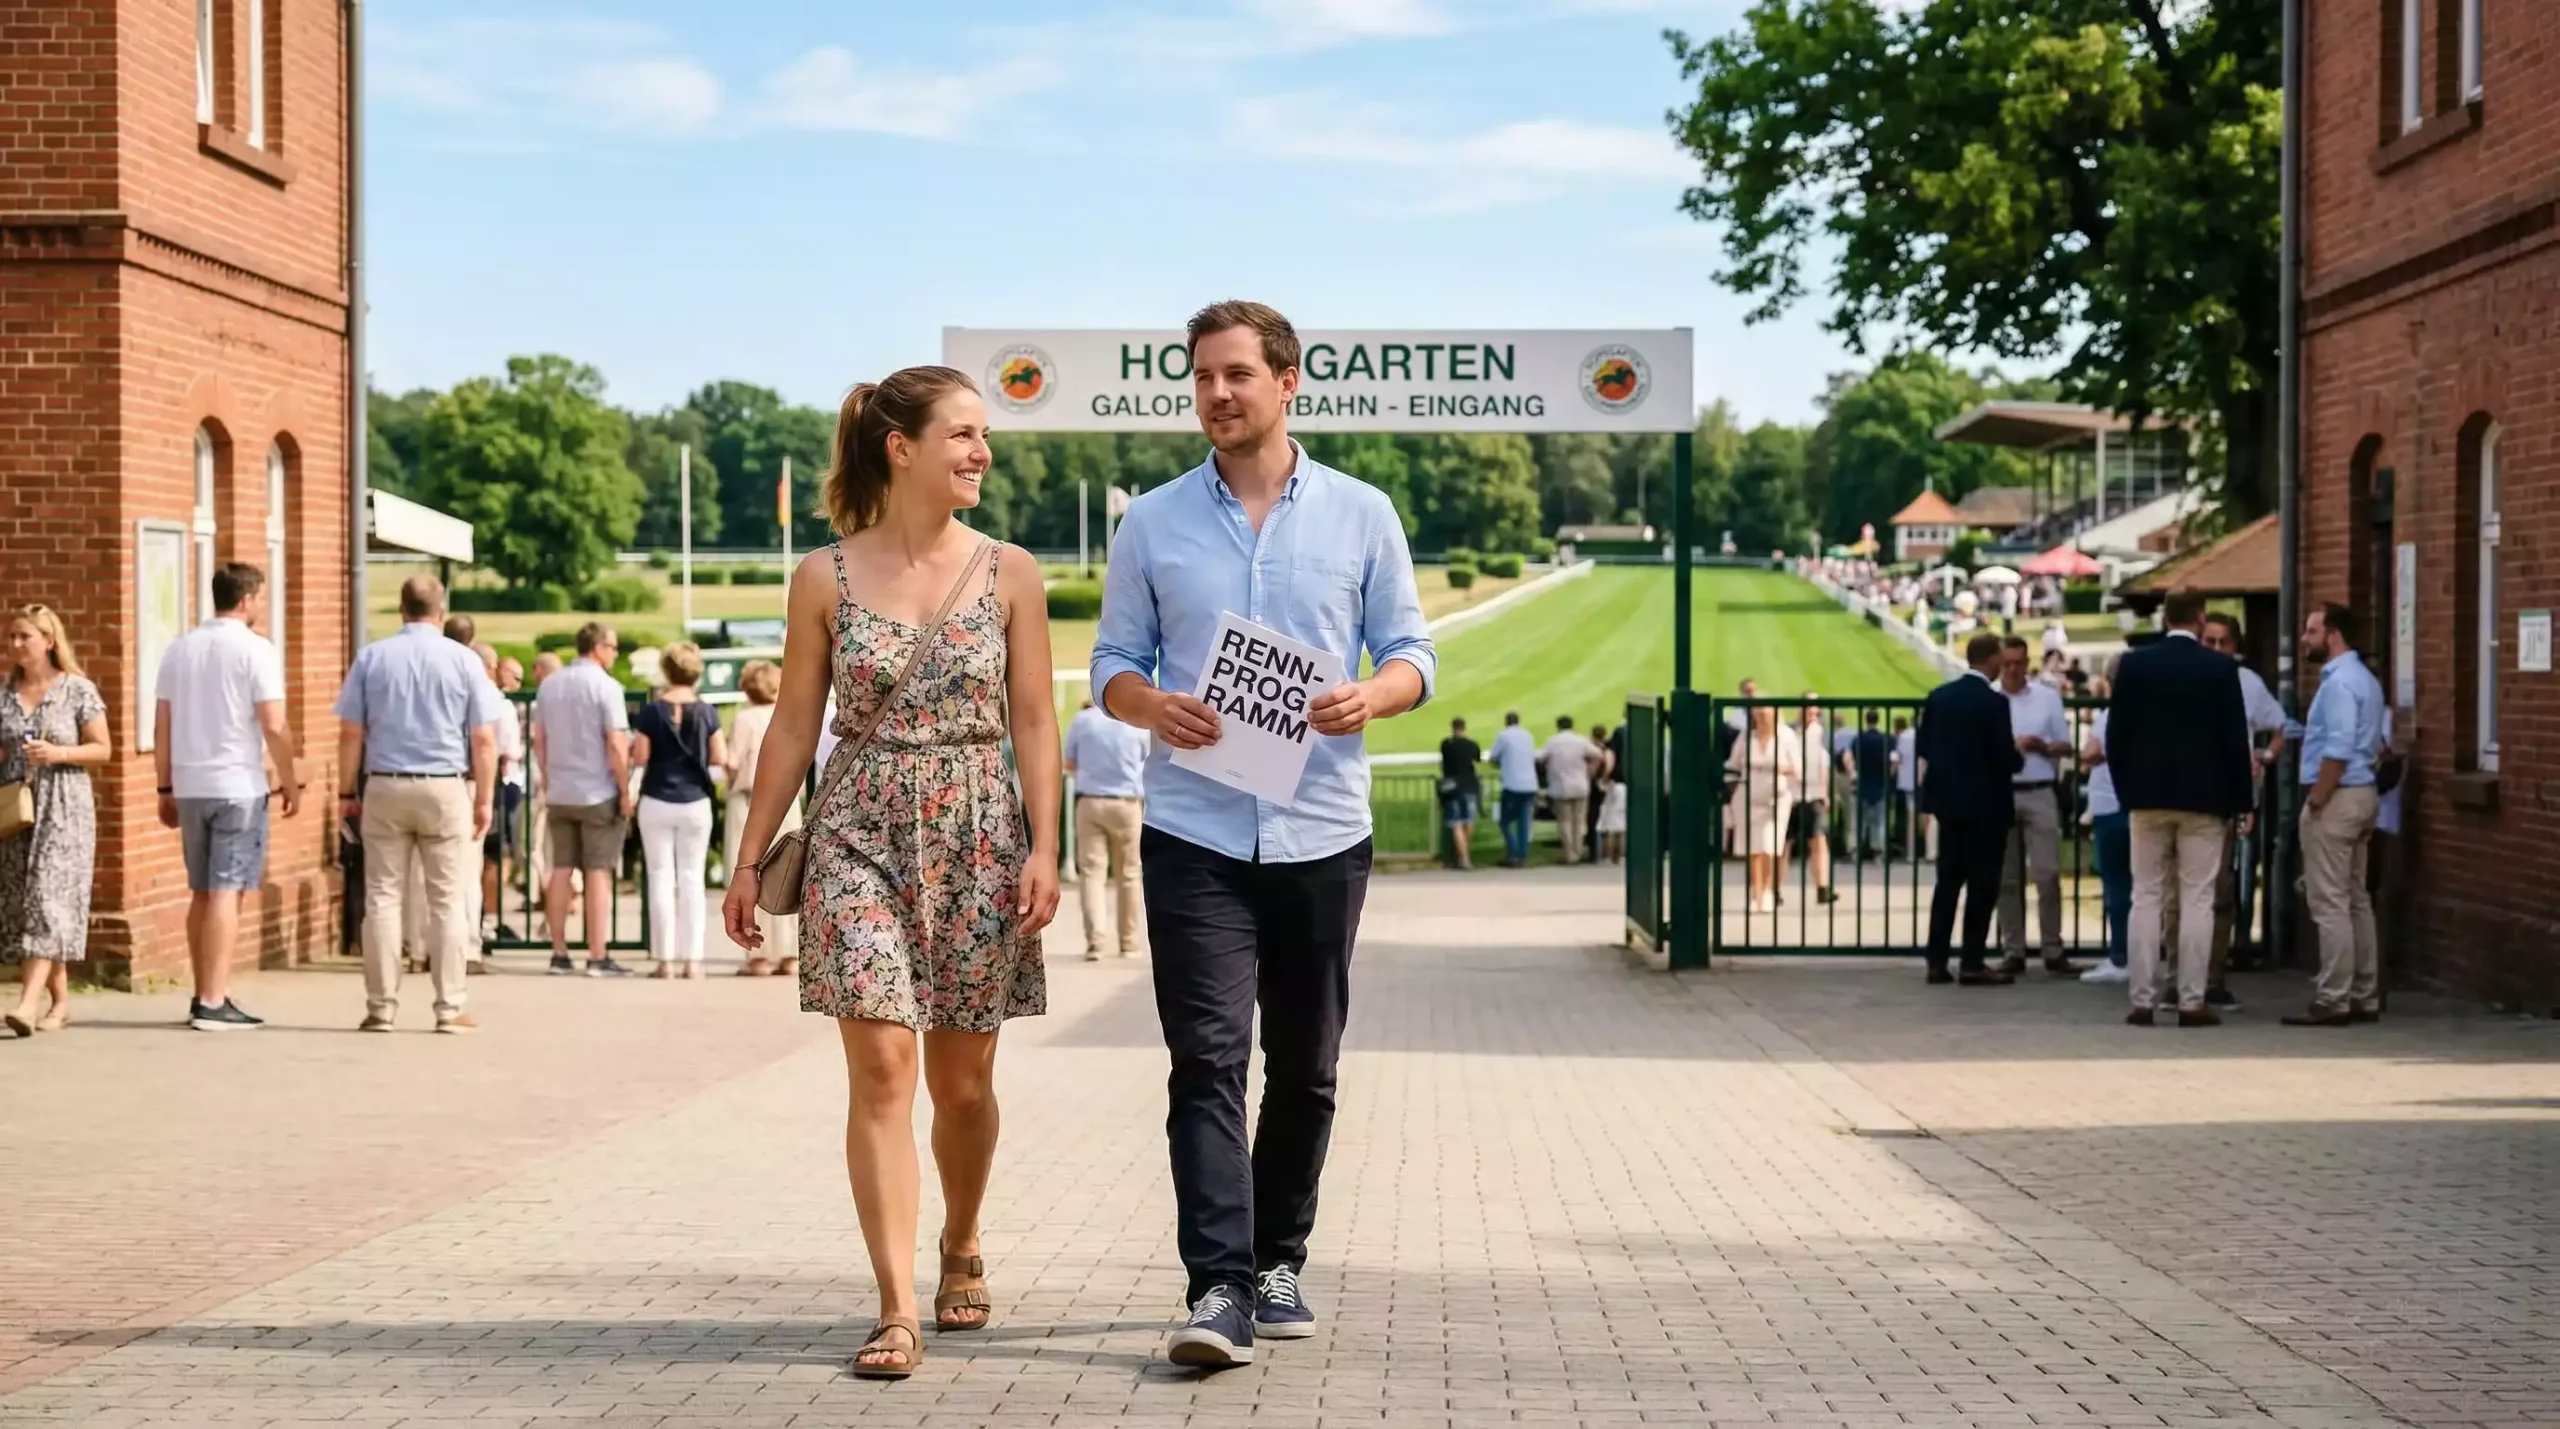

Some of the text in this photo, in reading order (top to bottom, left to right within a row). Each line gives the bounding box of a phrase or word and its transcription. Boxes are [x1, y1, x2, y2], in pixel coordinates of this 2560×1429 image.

[1120, 343, 1515, 381] HOGARTEN
[1409, 394, 1545, 417] EINGANG
[1211, 656, 1307, 714] PROG
[1220, 628, 1325, 685] RENN-
[1203, 683, 1309, 744] RAMM
